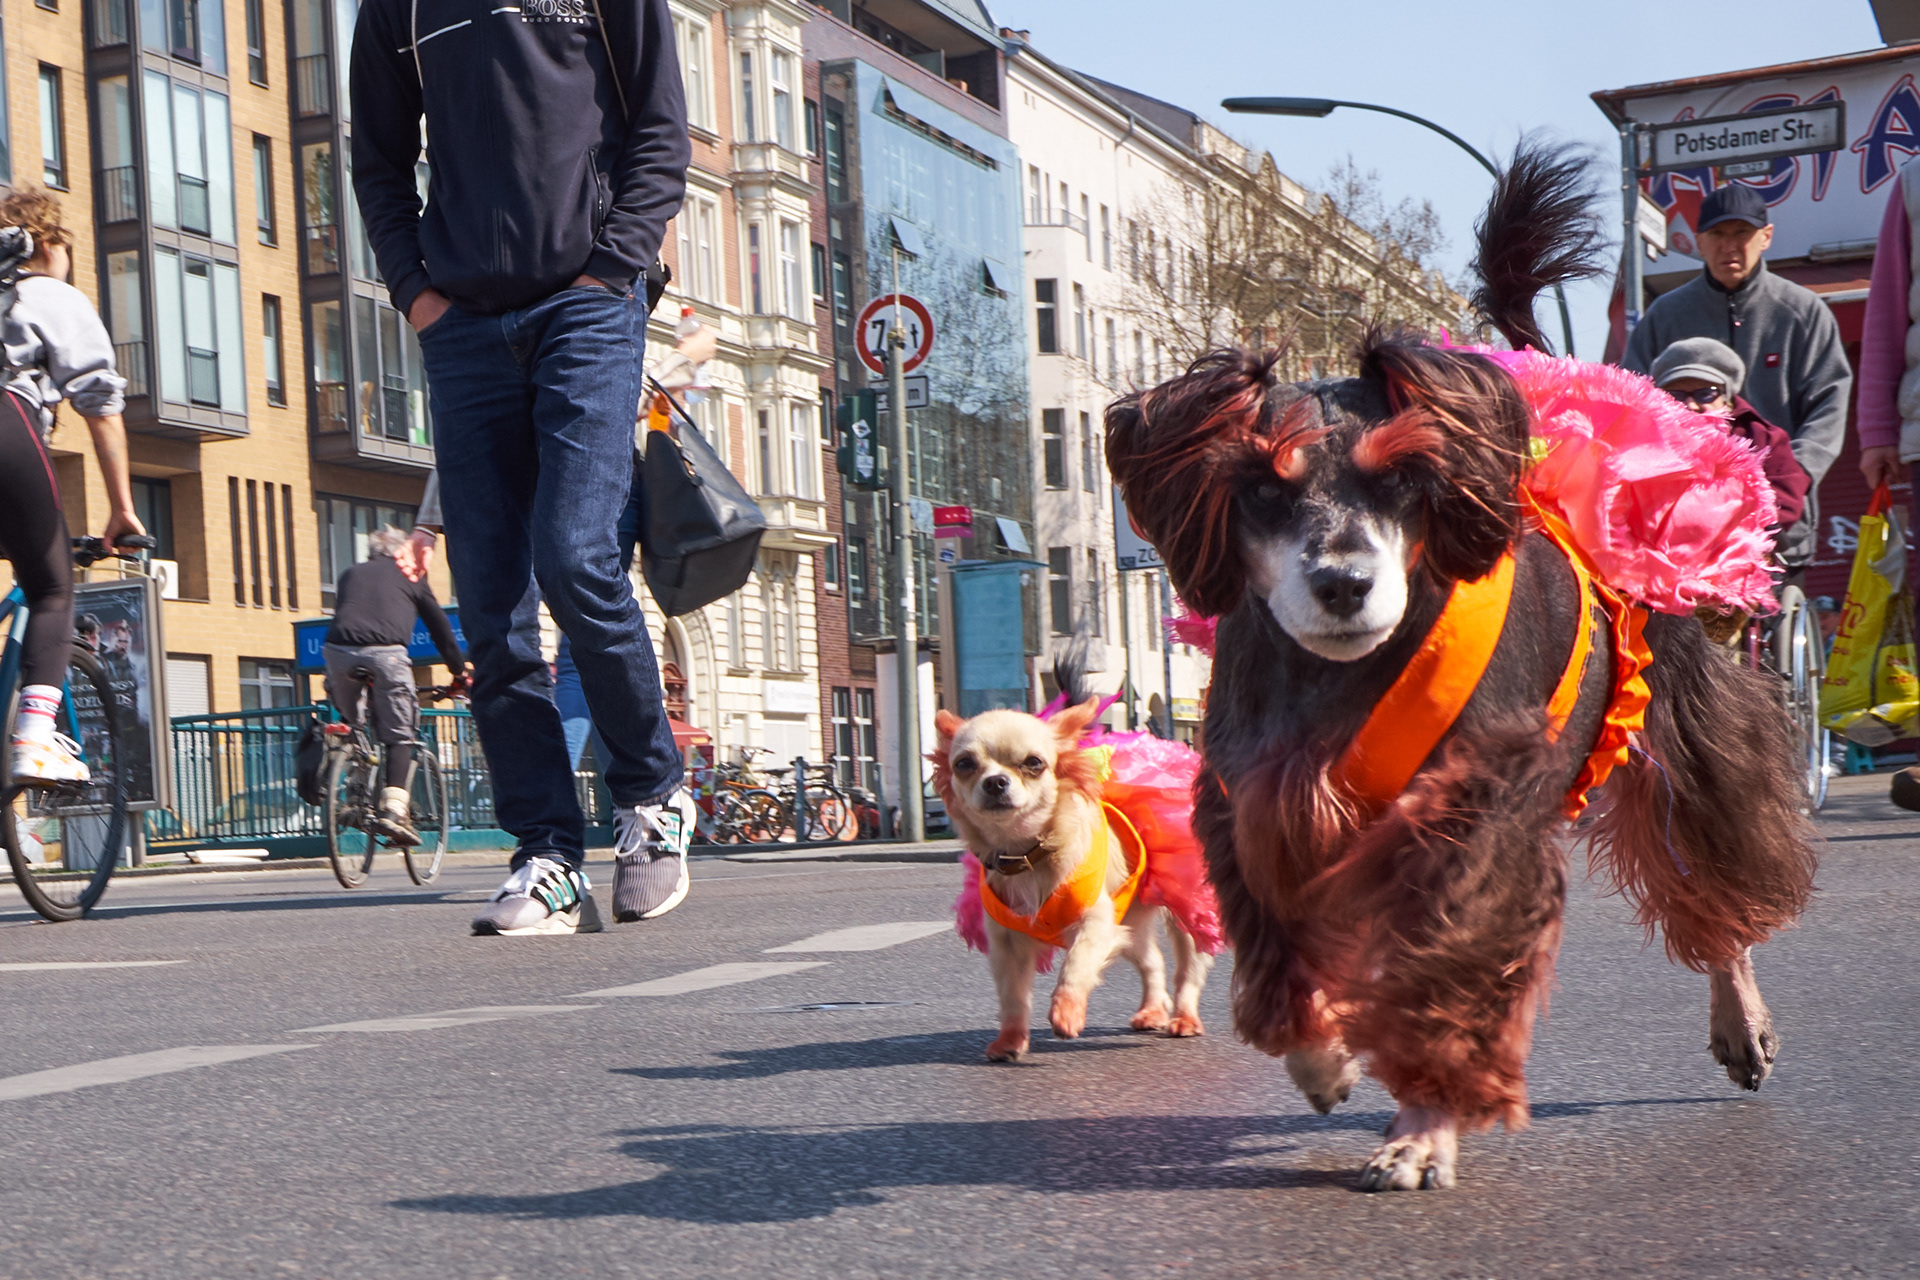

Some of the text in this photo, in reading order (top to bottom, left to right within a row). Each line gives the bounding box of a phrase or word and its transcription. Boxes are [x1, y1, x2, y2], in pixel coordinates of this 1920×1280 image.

[521, 0, 584, 17] BOSS
[1674, 118, 1817, 155] Potsdamer Str.
